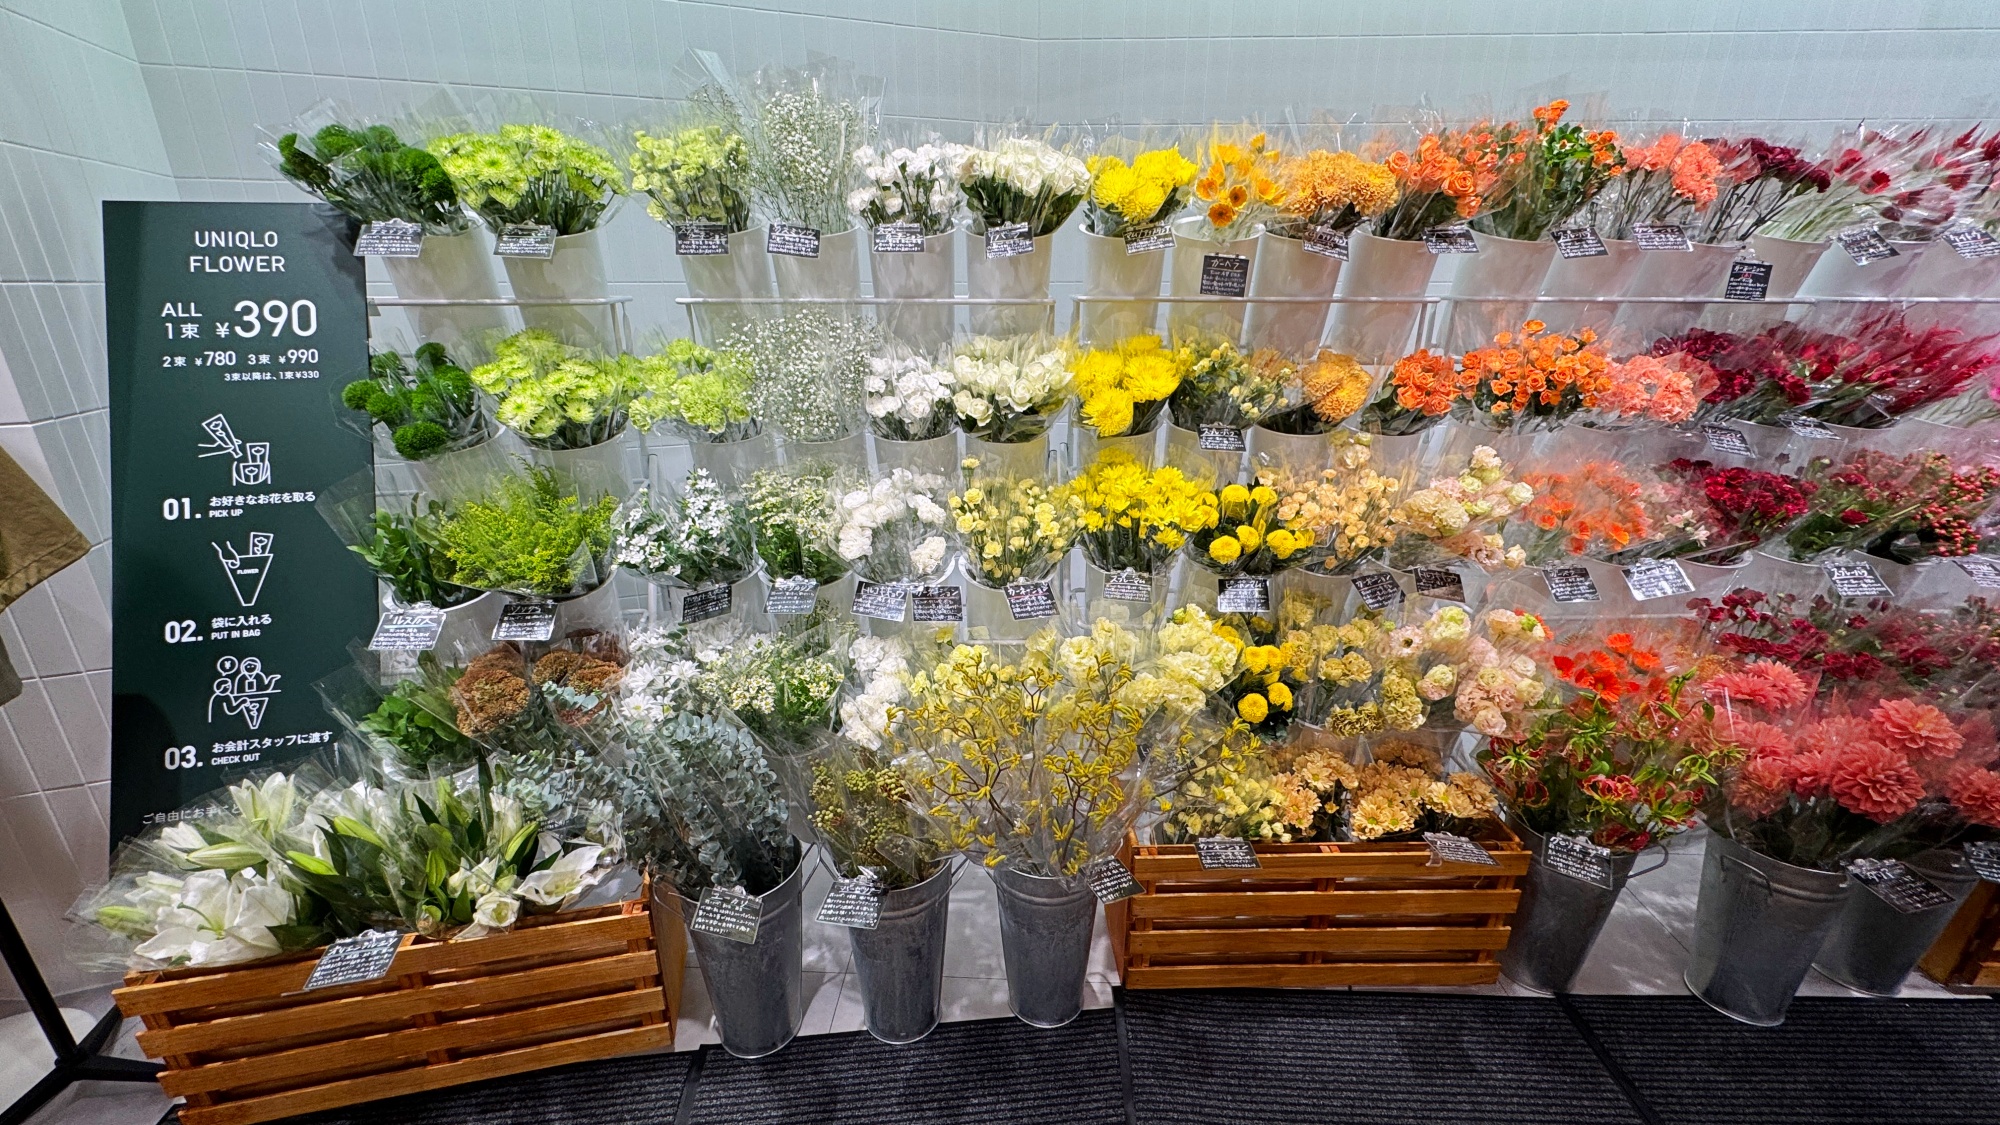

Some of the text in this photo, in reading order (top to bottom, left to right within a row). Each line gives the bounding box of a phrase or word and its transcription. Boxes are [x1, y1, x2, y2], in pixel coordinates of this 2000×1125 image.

[194, 230, 279, 250] UNIQLO
[189, 255, 286, 273] FLOWER
[1211, 259, 1241, 270] ガーベラ
[160, 302, 203, 318] ALL
[164, 299, 318, 340] 1束 ¥390
[162, 348, 319, 368] 2束 ¥780 3束 ¥990
[209, 491, 316, 508] お好きなお花を取る
[162, 497, 202, 521] 01.
[208, 508, 244, 519] PICK UP
[211, 613, 273, 629] 袋に入れる
[164, 619, 204, 644] 02.
[210, 628, 261, 641] PUT IN BAG
[211, 731, 333, 754] お会計スタッフに渡す
[164, 745, 204, 770] 03.
[210, 752, 261, 766] CHECK OUT
